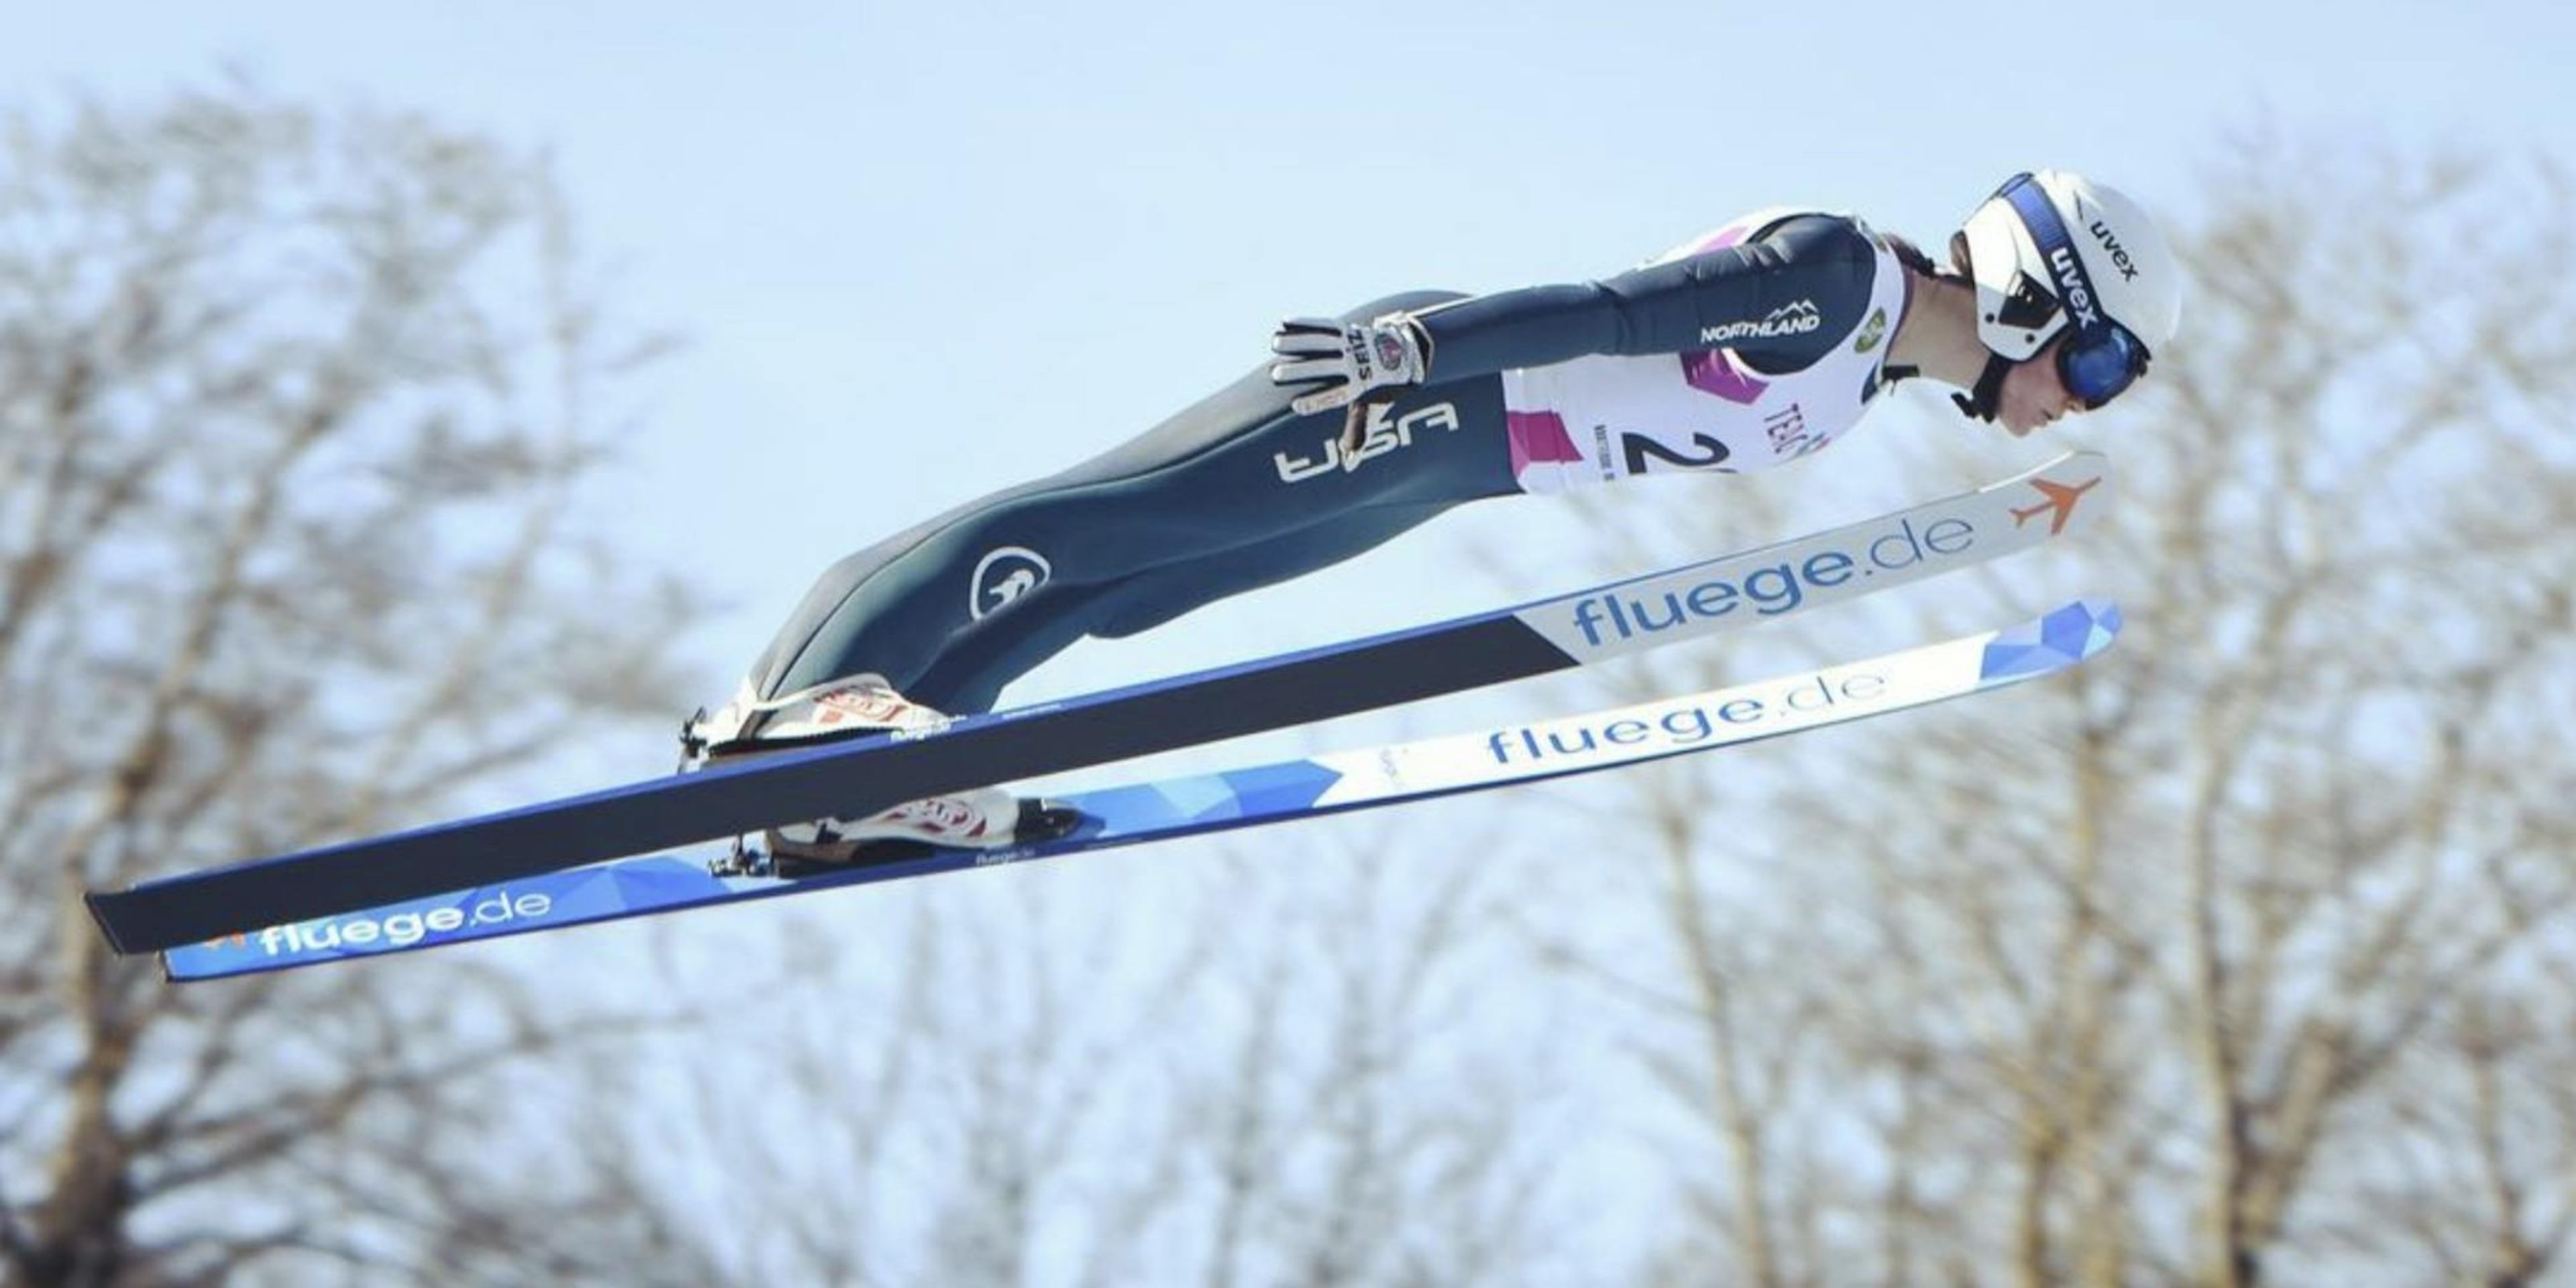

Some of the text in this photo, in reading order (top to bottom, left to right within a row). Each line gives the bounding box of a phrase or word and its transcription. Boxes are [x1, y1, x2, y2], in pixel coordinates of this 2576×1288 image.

[2090, 221, 2140, 282] uvex
[2049, 246, 2100, 329] uvex
[1700, 315, 1821, 344] NORTHLAND
[1621, 431, 1739, 474] 2
[1573, 517, 1974, 646] fluege.de
[1488, 674, 1888, 764] fluege.de
[259, 890, 552, 958] fluege.de
